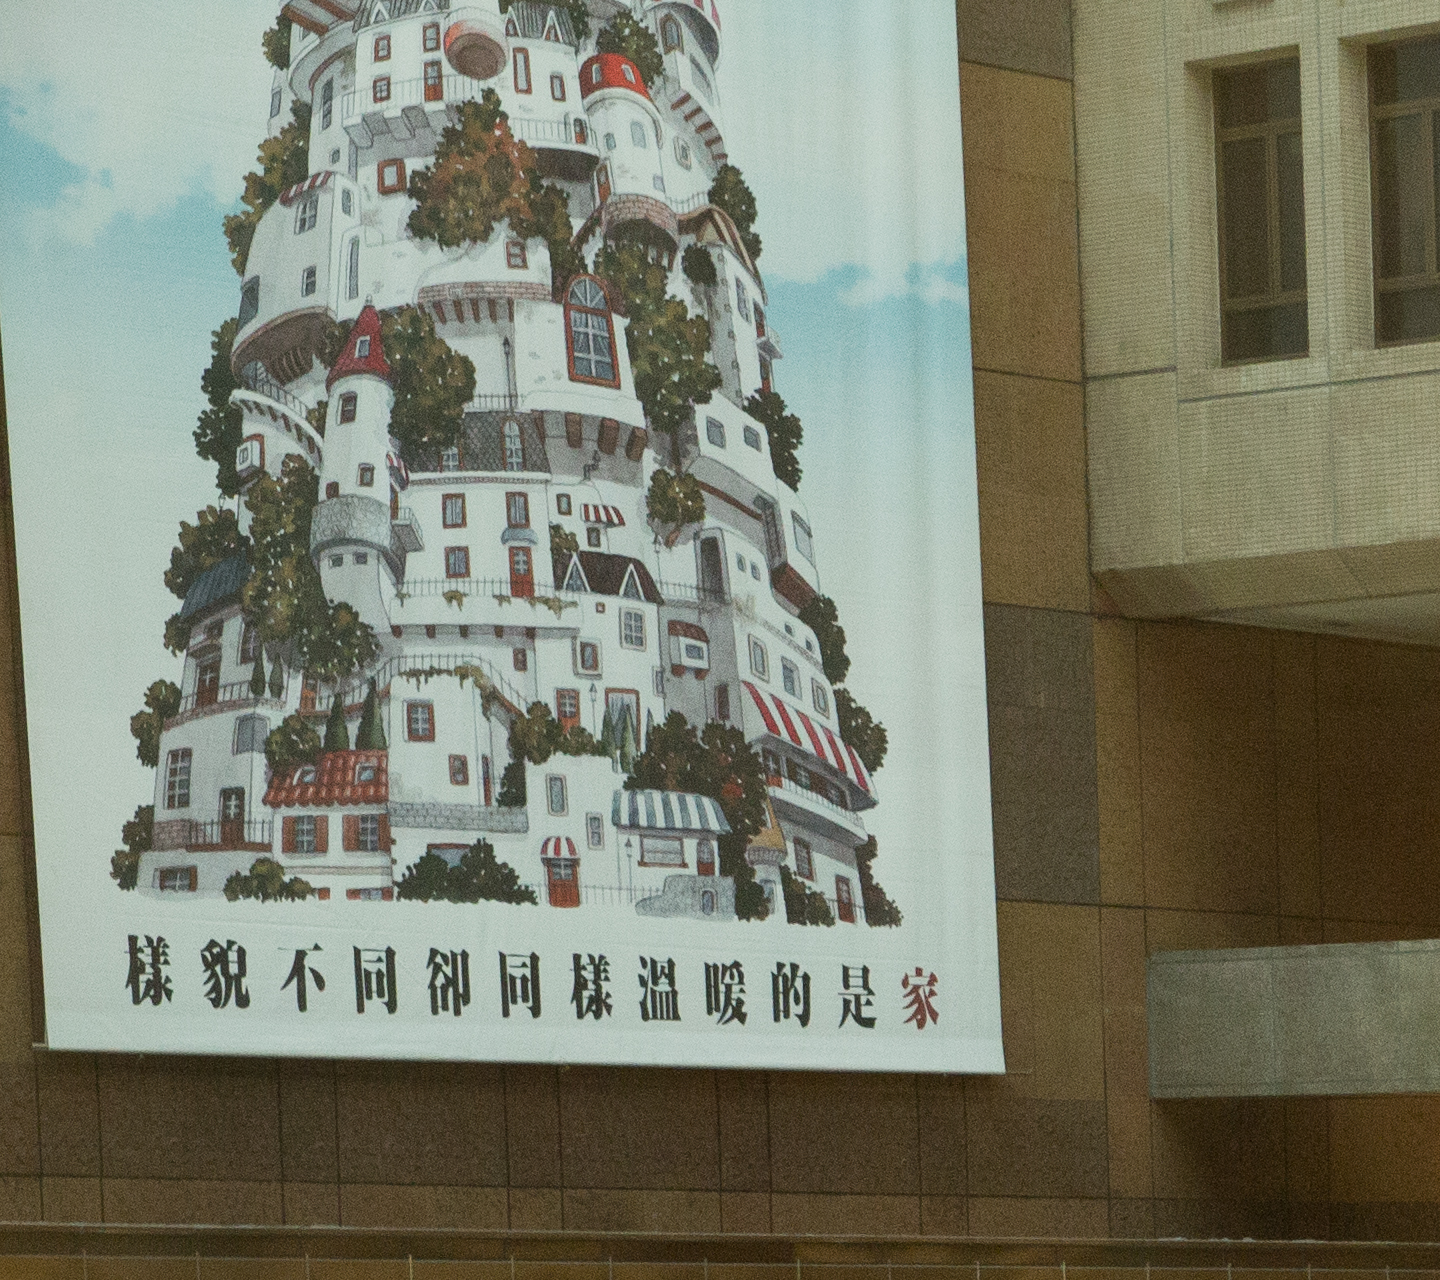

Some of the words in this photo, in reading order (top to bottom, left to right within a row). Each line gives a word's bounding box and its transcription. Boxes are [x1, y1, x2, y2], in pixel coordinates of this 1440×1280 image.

[122, 933, 940, 1031] 樣貌不同卻同樣溫暖的是家
